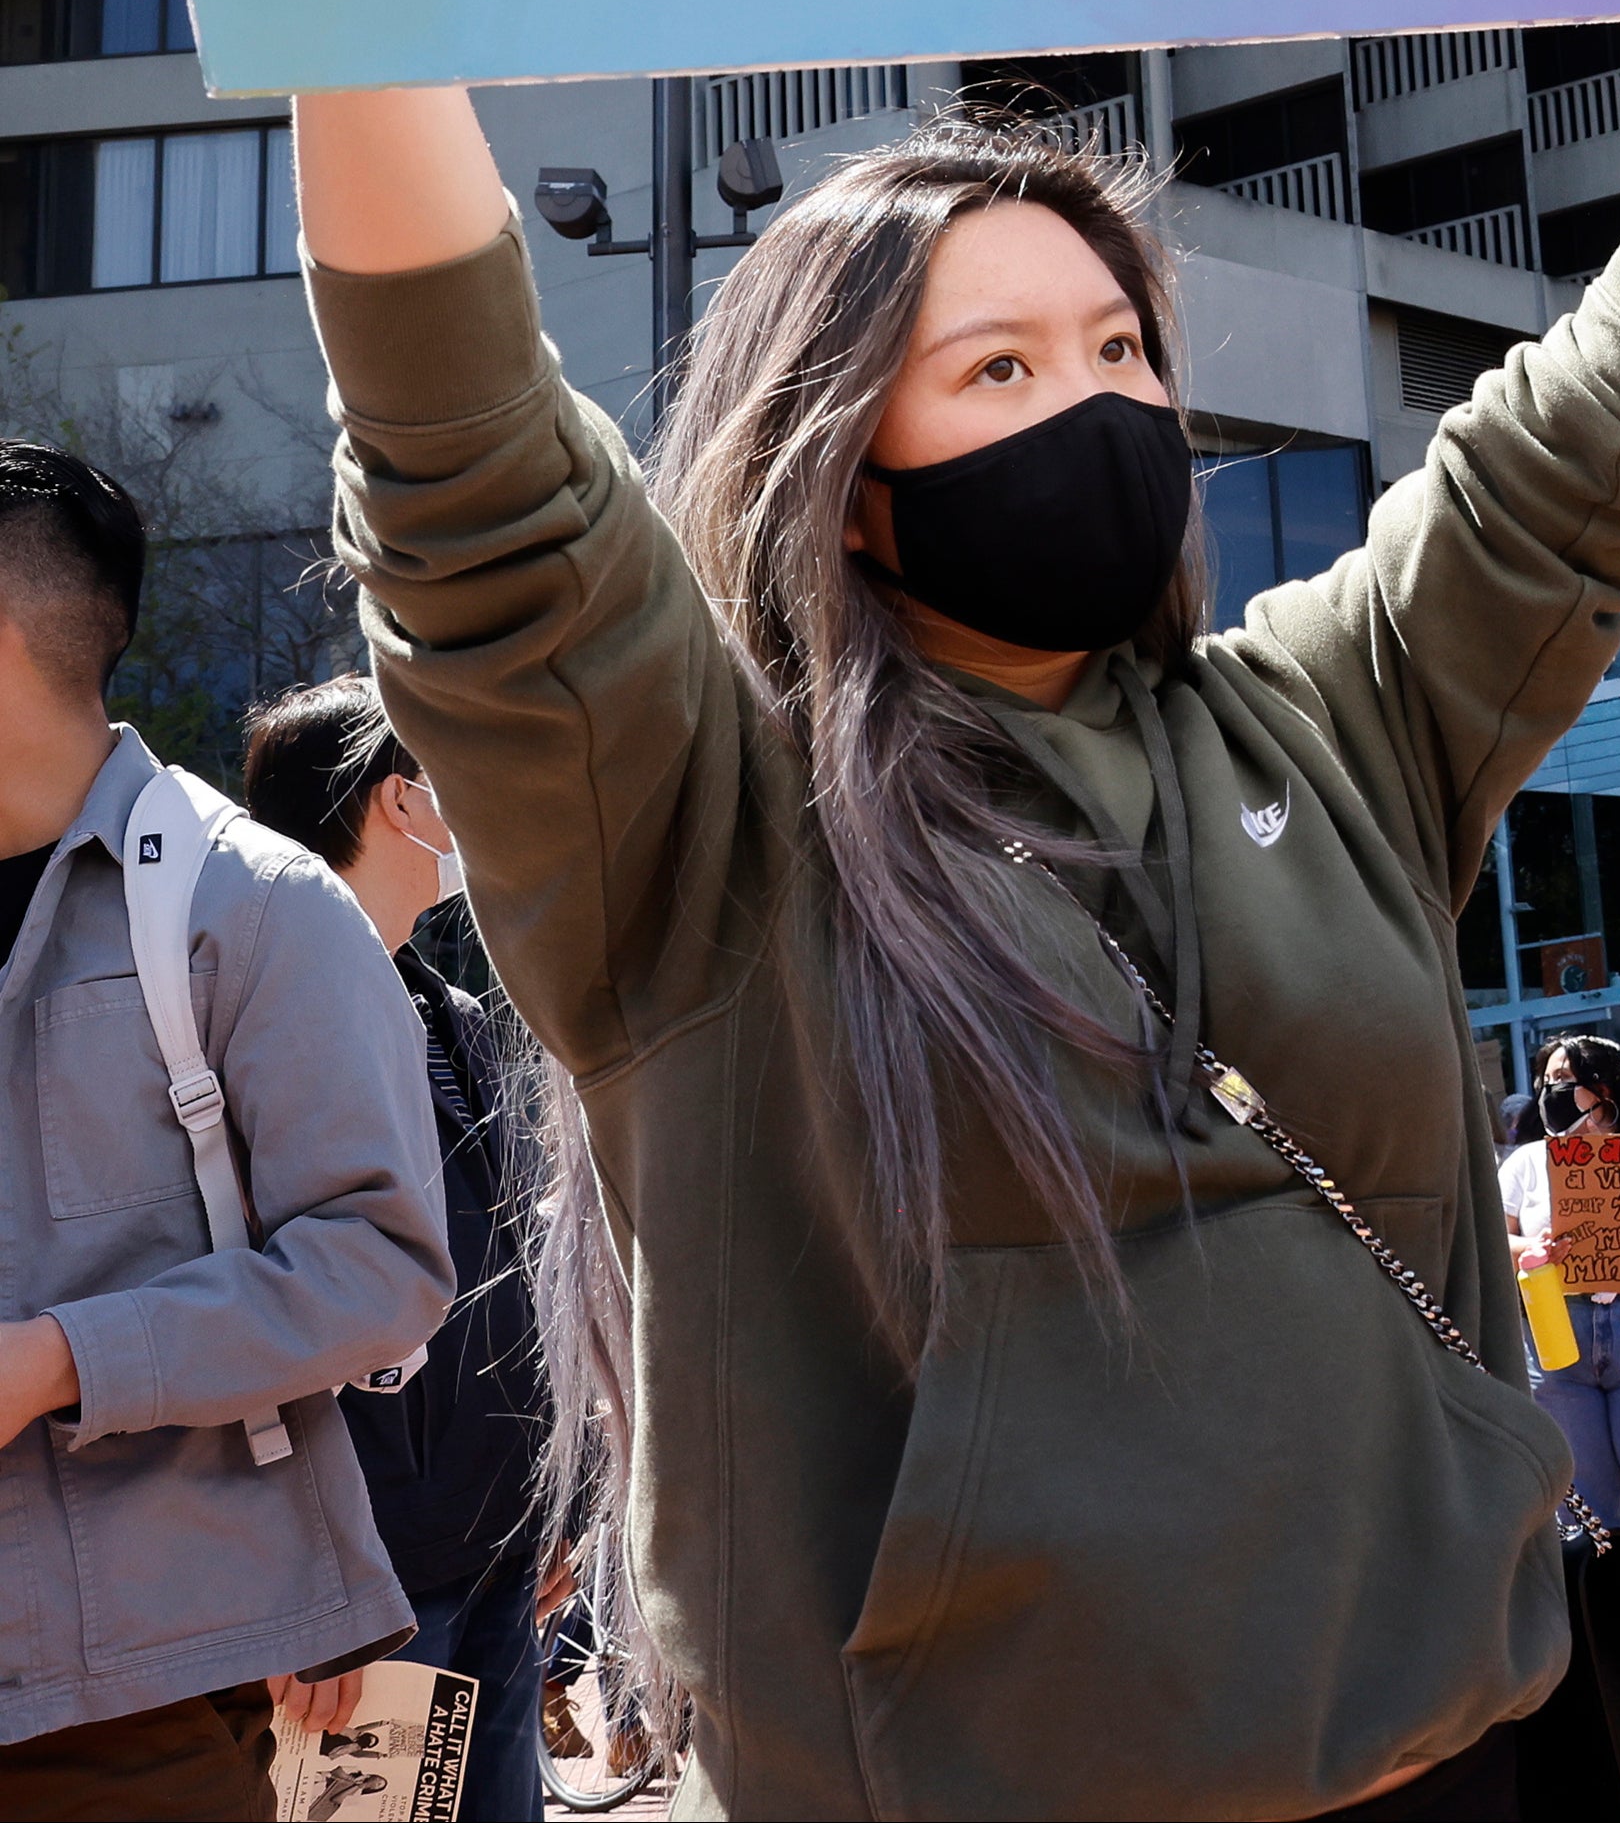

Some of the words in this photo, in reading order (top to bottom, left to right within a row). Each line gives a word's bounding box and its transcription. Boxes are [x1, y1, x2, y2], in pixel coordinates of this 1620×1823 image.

[1548, 1136, 1595, 1166] We
[1565, 1169, 1586, 1190] a
[1558, 1196, 1606, 1217] your
[432, 1705, 449, 1718] A
[449, 1690, 470, 1734] CALL
[424, 1721, 447, 1769] HATE
[446, 1738, 463, 1755] IT
[436, 1758, 460, 1812] WHAT
[434, 1814, 450, 1822] I
